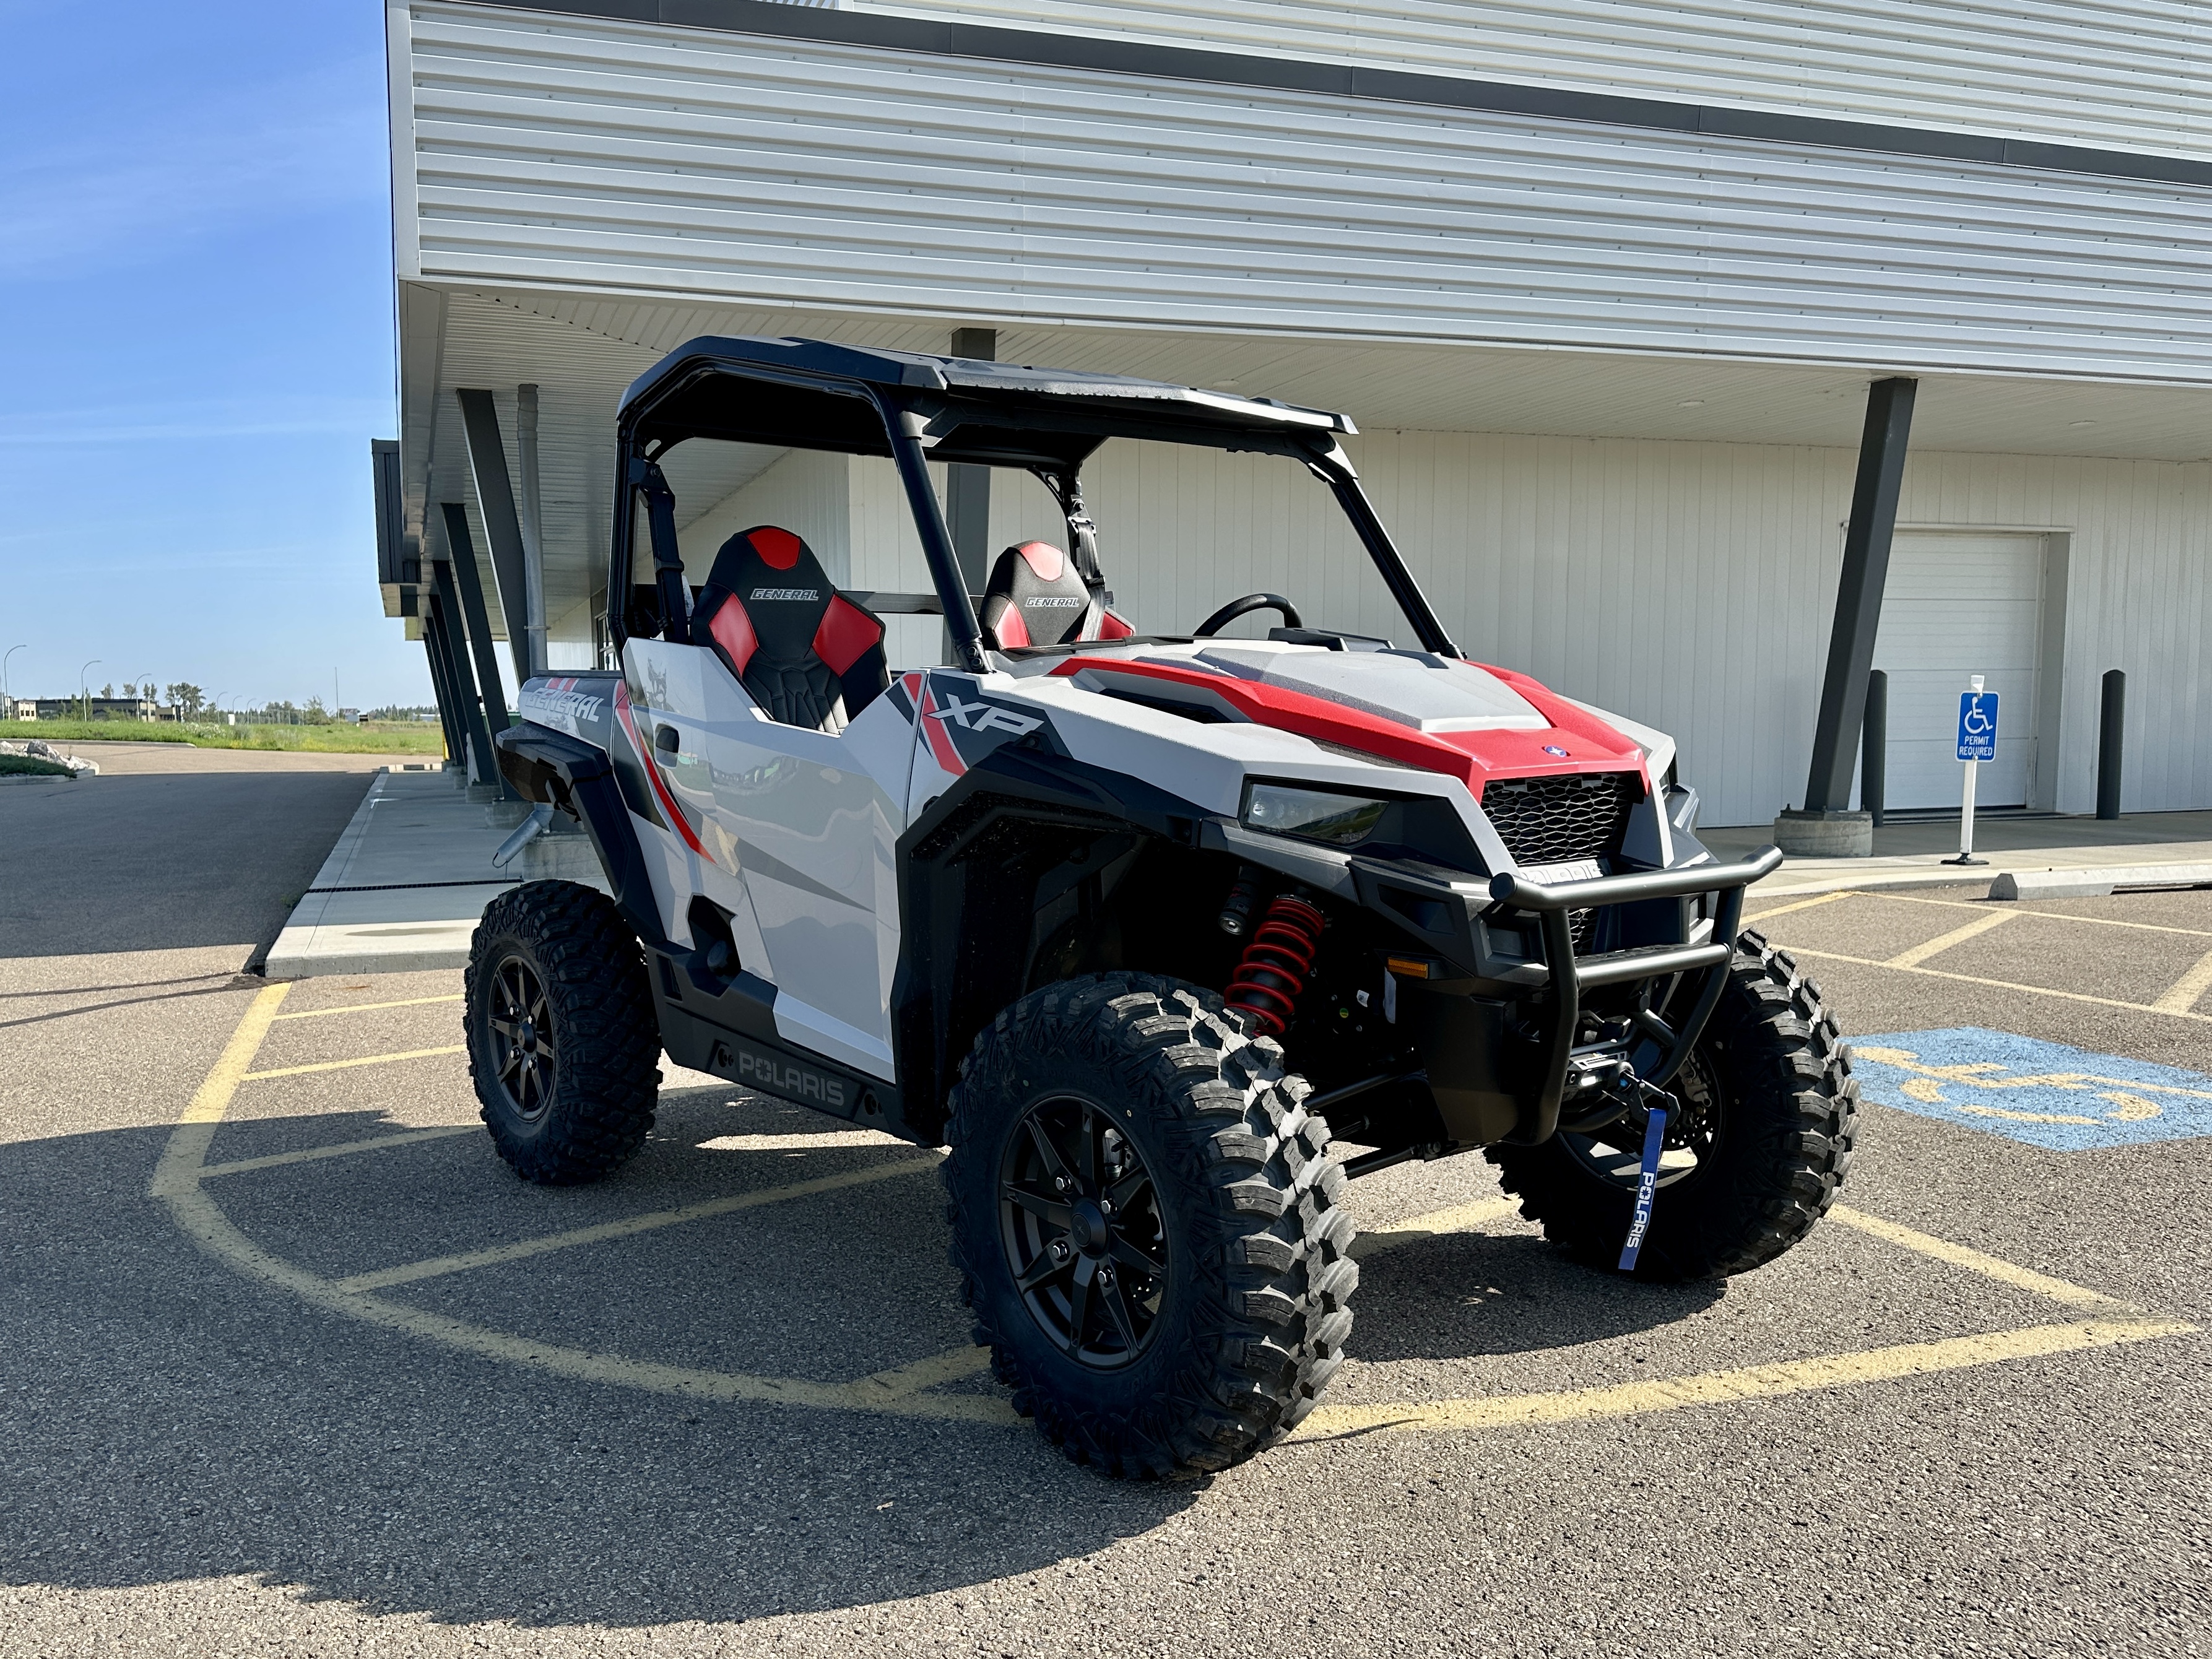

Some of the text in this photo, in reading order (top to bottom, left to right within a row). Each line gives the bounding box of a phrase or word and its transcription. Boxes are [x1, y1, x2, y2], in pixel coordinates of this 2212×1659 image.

[749, 588, 819, 601] GENERAL
[1025, 597, 1080, 607] GENERAL
[525, 687, 605, 722] GENERAL
[927, 692, 1045, 736] XP
[1959, 745, 1993, 756] REQUIRED
[1964, 735, 1990, 745] PERMIT
[739, 1051, 844, 1107] POLARIS
[1626, 1171, 1655, 1248] POLARIS
